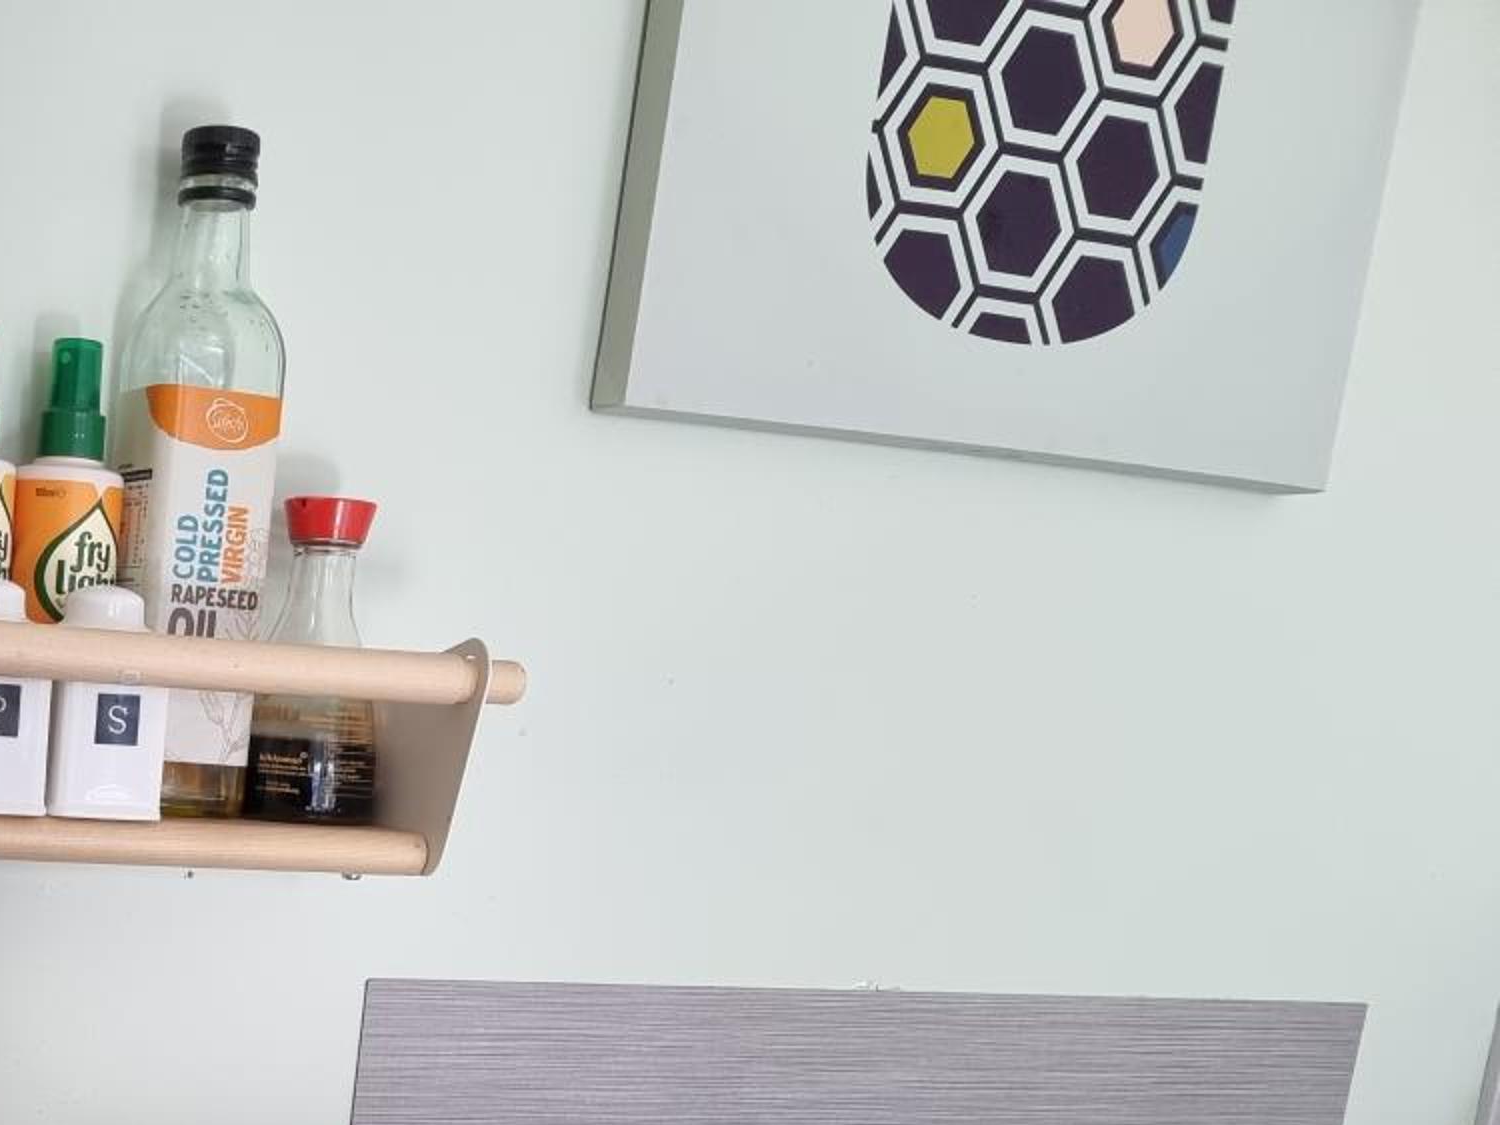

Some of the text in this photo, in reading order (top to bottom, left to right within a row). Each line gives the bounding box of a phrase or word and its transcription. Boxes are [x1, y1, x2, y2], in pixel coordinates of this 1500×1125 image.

[69, 531, 111, 573] fry
[173, 515, 199, 579] COLD
[197, 469, 229, 583] PRESSED
[220, 505, 249, 584] VIRGIN
[170, 583, 258, 610] RAPESEED
[107, 705, 129, 735] S
